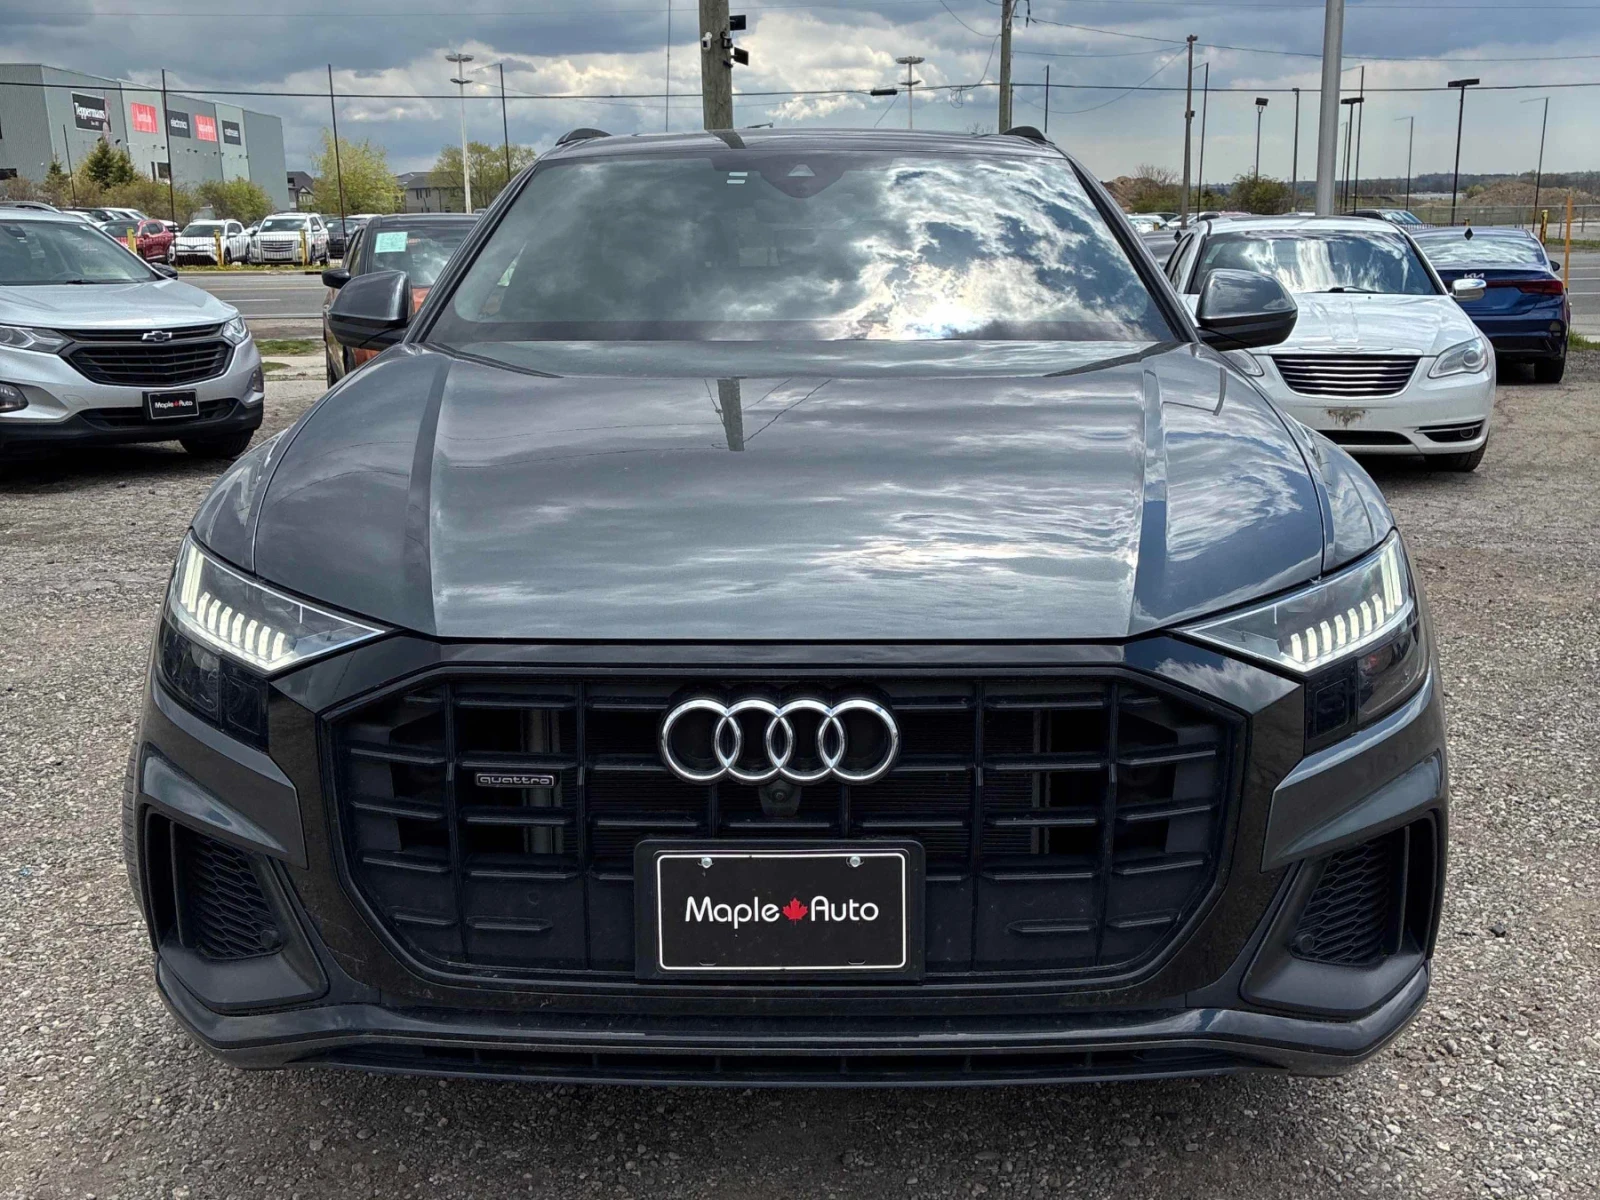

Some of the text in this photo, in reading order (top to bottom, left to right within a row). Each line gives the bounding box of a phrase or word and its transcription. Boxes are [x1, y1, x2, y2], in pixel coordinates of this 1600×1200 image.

[154, 401, 174, 409] Maple
[480, 776, 550, 784] quattro
[685, 895, 879, 929] Maple Auto
